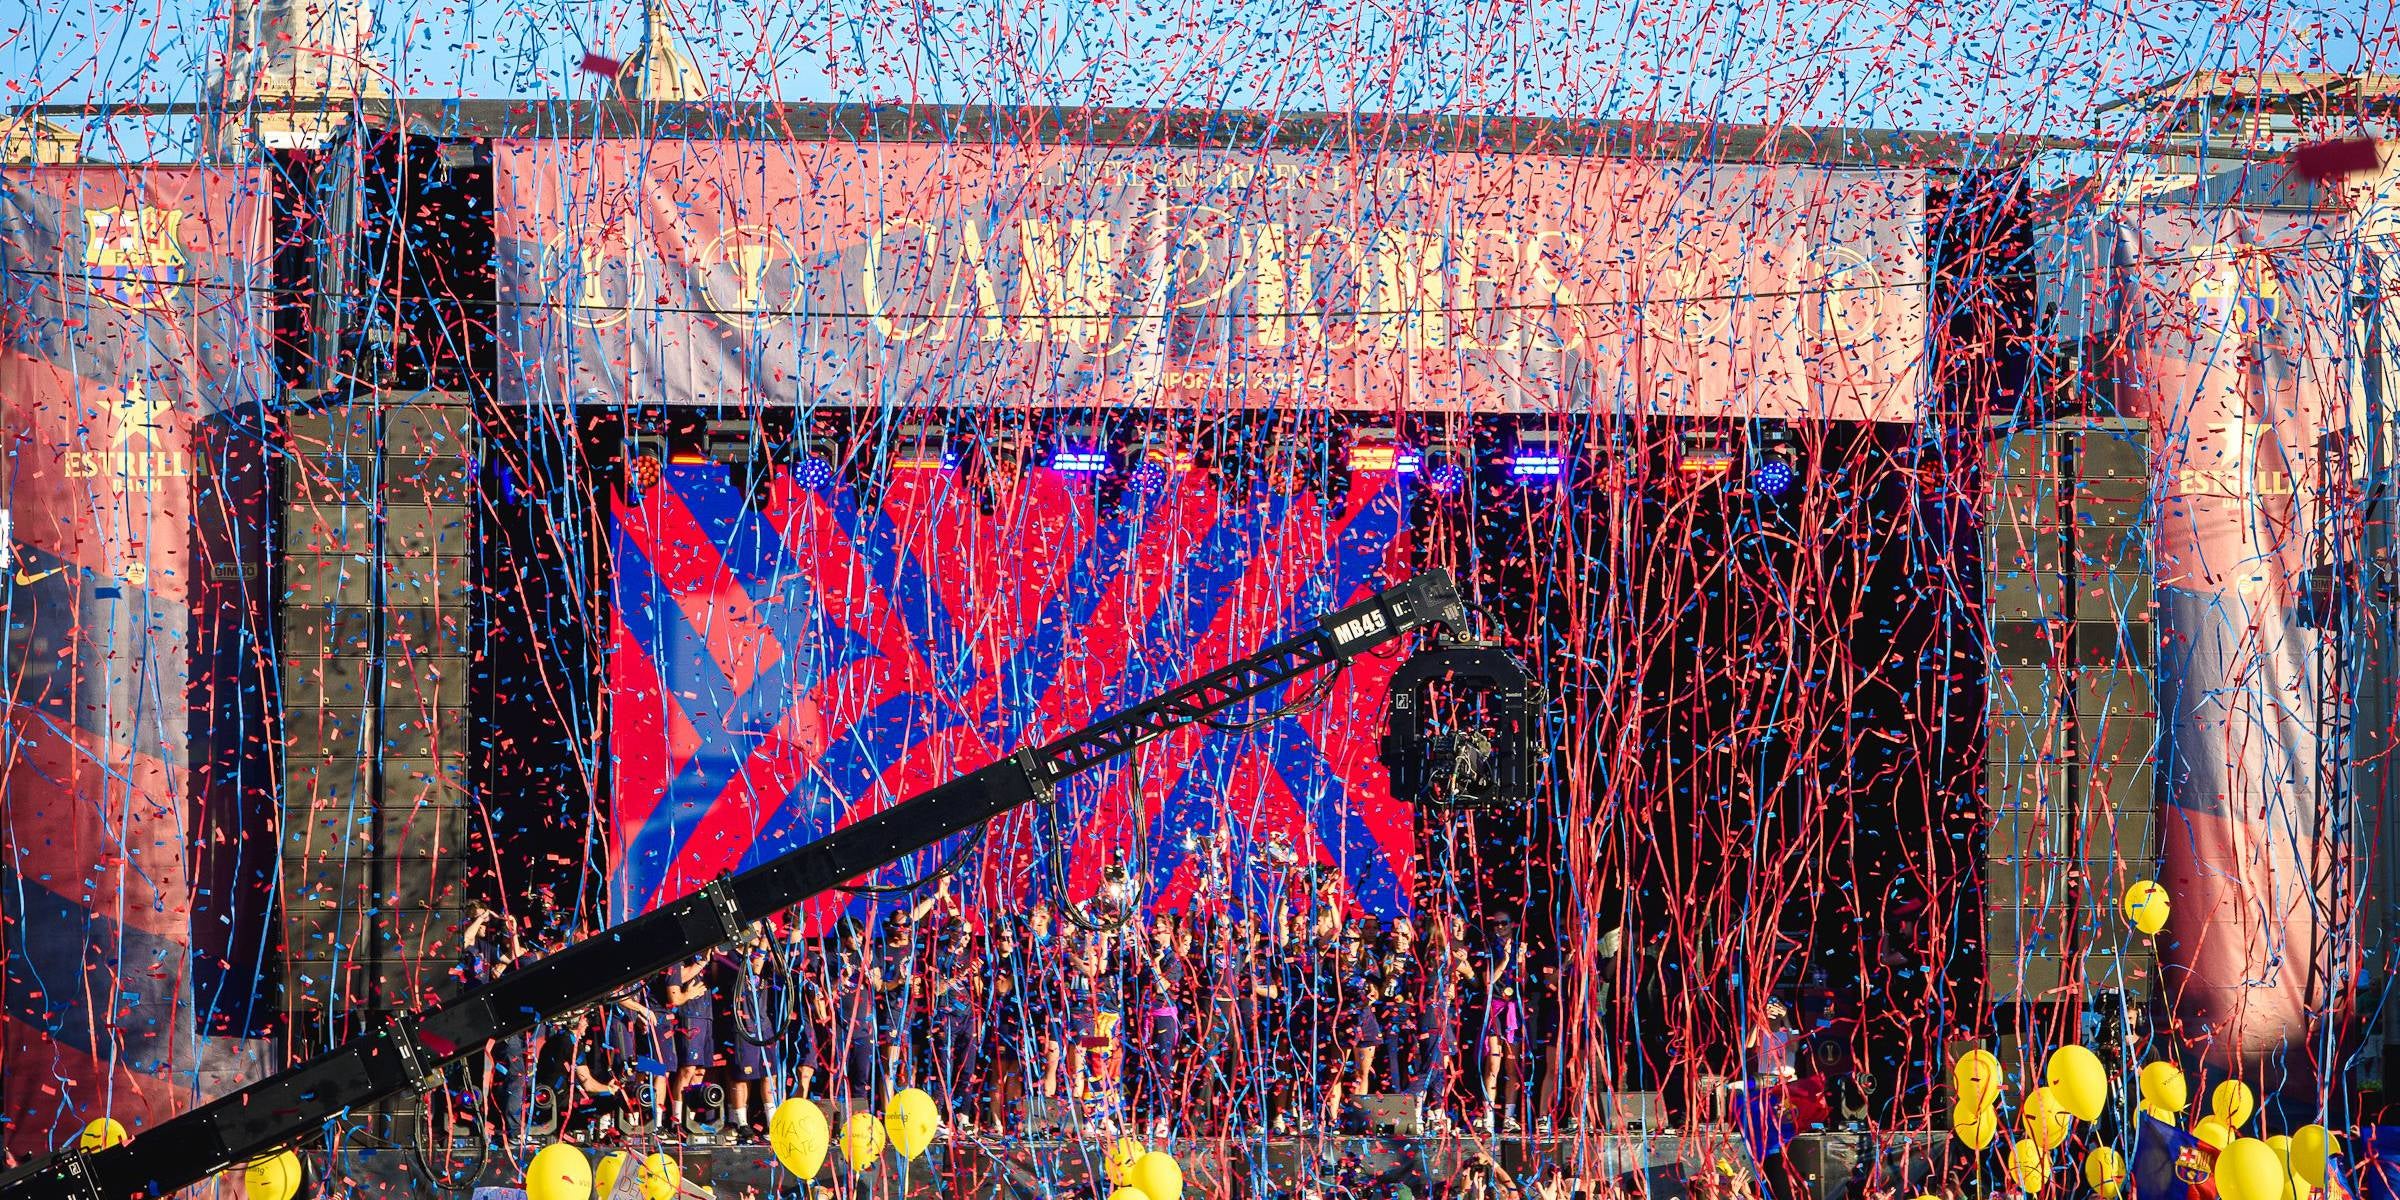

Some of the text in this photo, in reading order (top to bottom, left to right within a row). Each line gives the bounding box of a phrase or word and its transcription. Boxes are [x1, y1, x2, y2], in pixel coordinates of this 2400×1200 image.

[863, 205, 1588, 357] CAMPIONES
[64, 451, 209, 478] ESTRELLA
[2179, 470, 2305, 495] ESTRLLA
[1333, 608, 1387, 645] MB45
